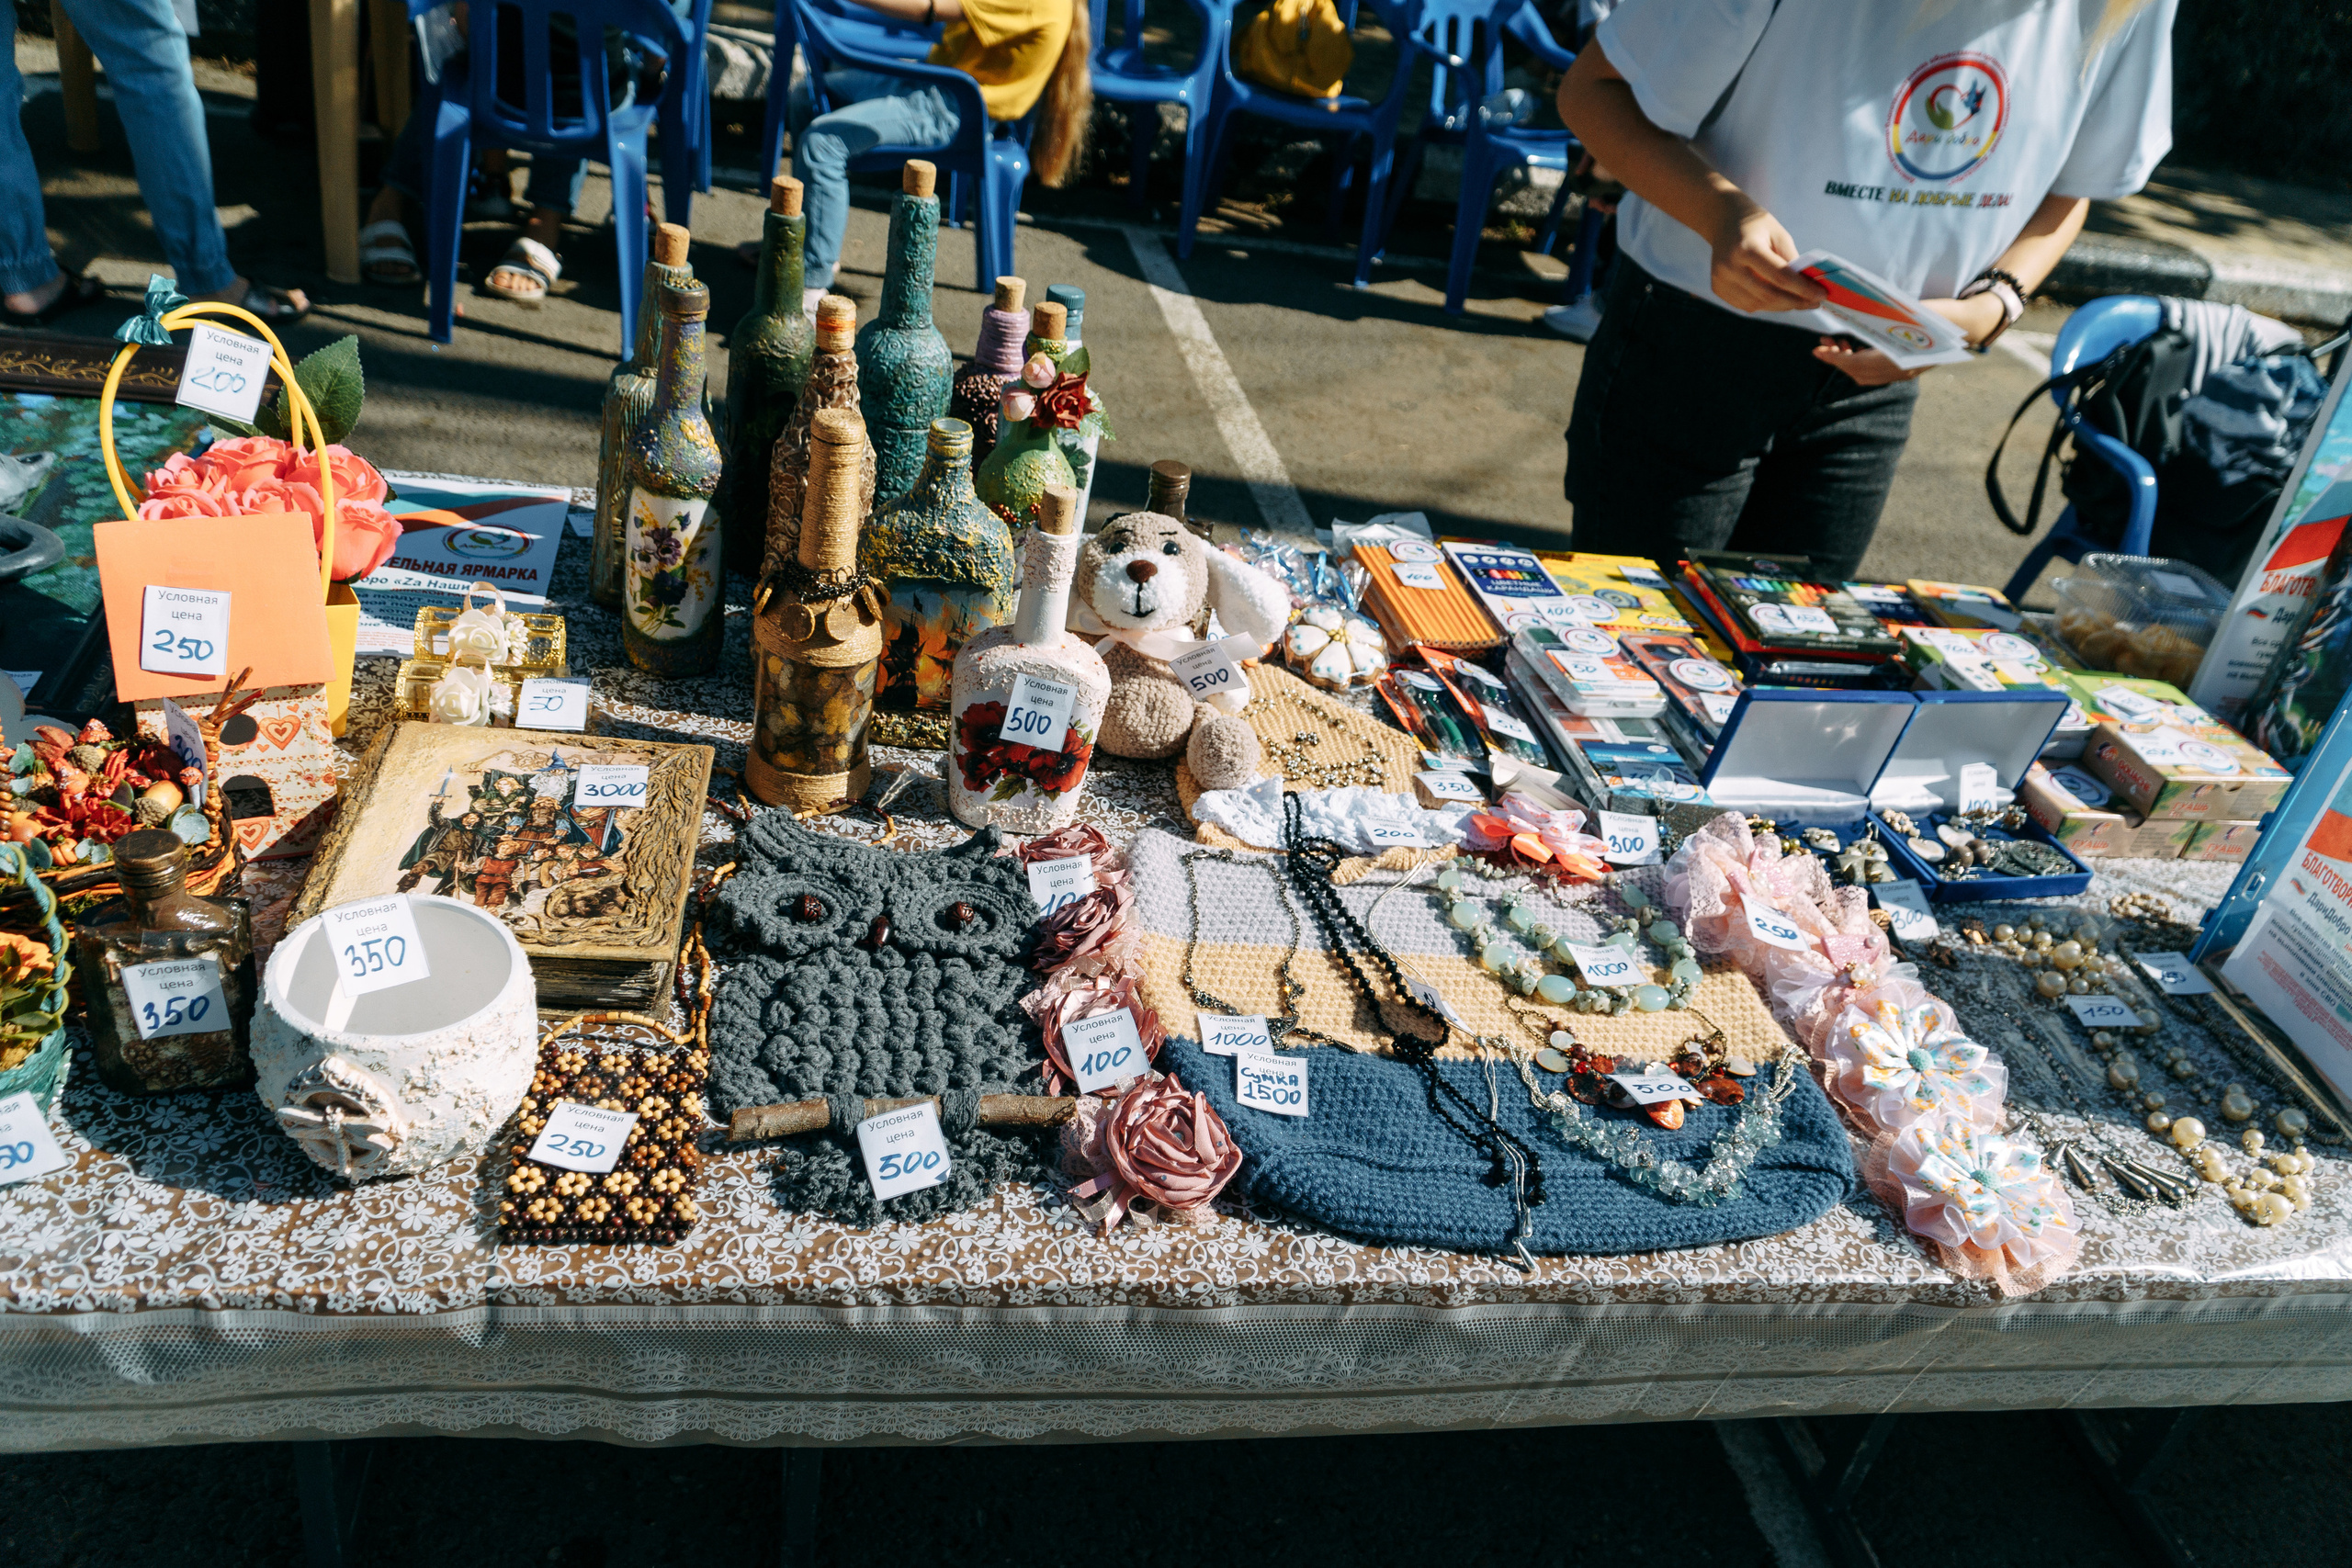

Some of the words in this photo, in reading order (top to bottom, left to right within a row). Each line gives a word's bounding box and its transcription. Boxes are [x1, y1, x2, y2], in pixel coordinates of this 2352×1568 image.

[1825, 180, 1884, 200] ВМЕСТЕ
[1889, 187, 1909, 203] НА
[1912, 189, 1974, 207] ДОБРЫЕ
[207, 331, 259, 355] Условная
[215, 351, 243, 367] цена
[190, 366, 246, 393] 200
[460, 563, 537, 581] ЯРМАРКА
[426, 579, 471, 591] Наши
[2259, 571, 2317, 597] БЛАГОТВ
[158, 590, 219, 605] Условная
[172, 609, 202, 624] цена
[1547, 606, 1575, 615] 100
[2271, 606, 2295, 626] Дар
[153, 629, 214, 660] 250
[1177, 647, 1216, 666] Условная
[1192, 658, 1213, 671] цена
[1023, 678, 1069, 696] Условная
[1190, 668, 1229, 692] 500
[1031, 694, 1054, 707] цена
[1007, 706, 1052, 735] 500
[175, 735, 203, 770] 200
[583, 782, 648, 797] 3000
[2172, 802, 2209, 812] ГУАШЬ
[1608, 814, 1647, 824] Условная
[1374, 829, 1415, 838] 200
[1609, 834, 1645, 853] 300
[2071, 839, 2109, 850] ГУАШЬ
[2206, 843, 2244, 854] ГУАШЬ
[1035, 861, 1083, 874] Условная
[1049, 876, 1074, 888] цена
[2301, 851, 2352, 909] БЛАГОТВОРИ
[334, 901, 398, 924] Условная
[1891, 909, 1924, 930] 300
[2307, 891, 2351, 935] ДариДобро
[356, 920, 389, 937] цена
[1755, 917, 1798, 940] 250
[345, 935, 406, 978] 350
[2331, 945, 2352, 970] пойду
[138, 961, 206, 978] Условная
[1588, 962, 1628, 976] 1000
[160, 978, 194, 991] цена
[2320, 989, 2337, 1008] СВО
[142, 994, 210, 1031] 350
[1206, 1014, 1256, 1023] Условная
[2084, 1005, 2125, 1018] 150
[1071, 1014, 1124, 1034] Условная
[1089, 1030, 1115, 1043] цена
[1209, 1032, 1267, 1046] 1000
[1080, 1046, 1132, 1076] 100
[1247, 1052, 1296, 1066] Условная
[1243, 1081, 1301, 1105] 1500
[567, 1105, 625, 1124] Условная
[867, 1110, 924, 1134] Условная
[574, 1120, 605, 1134] цена
[885, 1128, 915, 1145] цена
[547, 1133, 605, 1159] 250
[878, 1150, 941, 1181] 500
